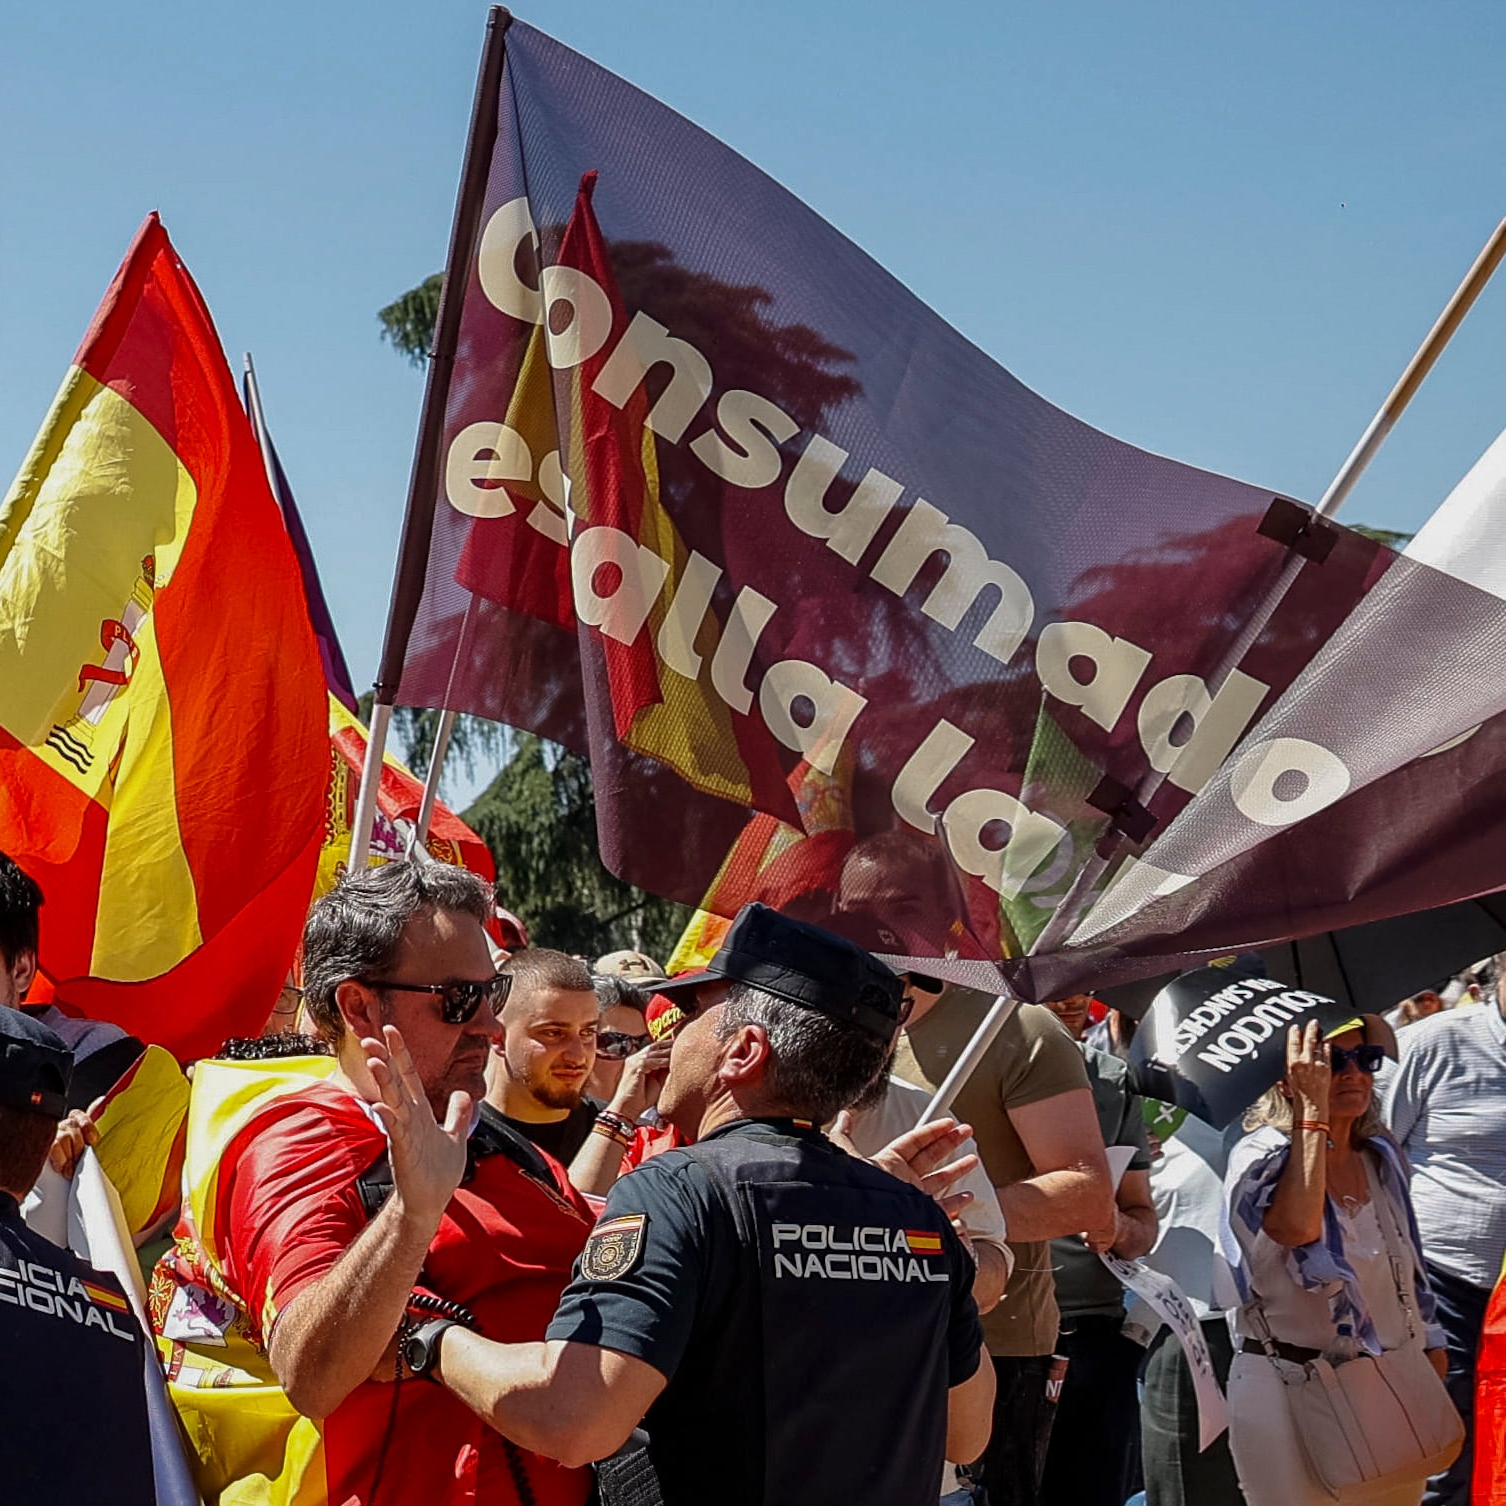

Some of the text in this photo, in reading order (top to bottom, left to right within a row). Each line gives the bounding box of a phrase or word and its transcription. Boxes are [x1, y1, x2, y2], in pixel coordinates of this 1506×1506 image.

[478, 195, 1351, 826] Consumado
[772, 1223, 912, 1254] POLICÍA
[774, 1253, 950, 1283] NACIONAL
